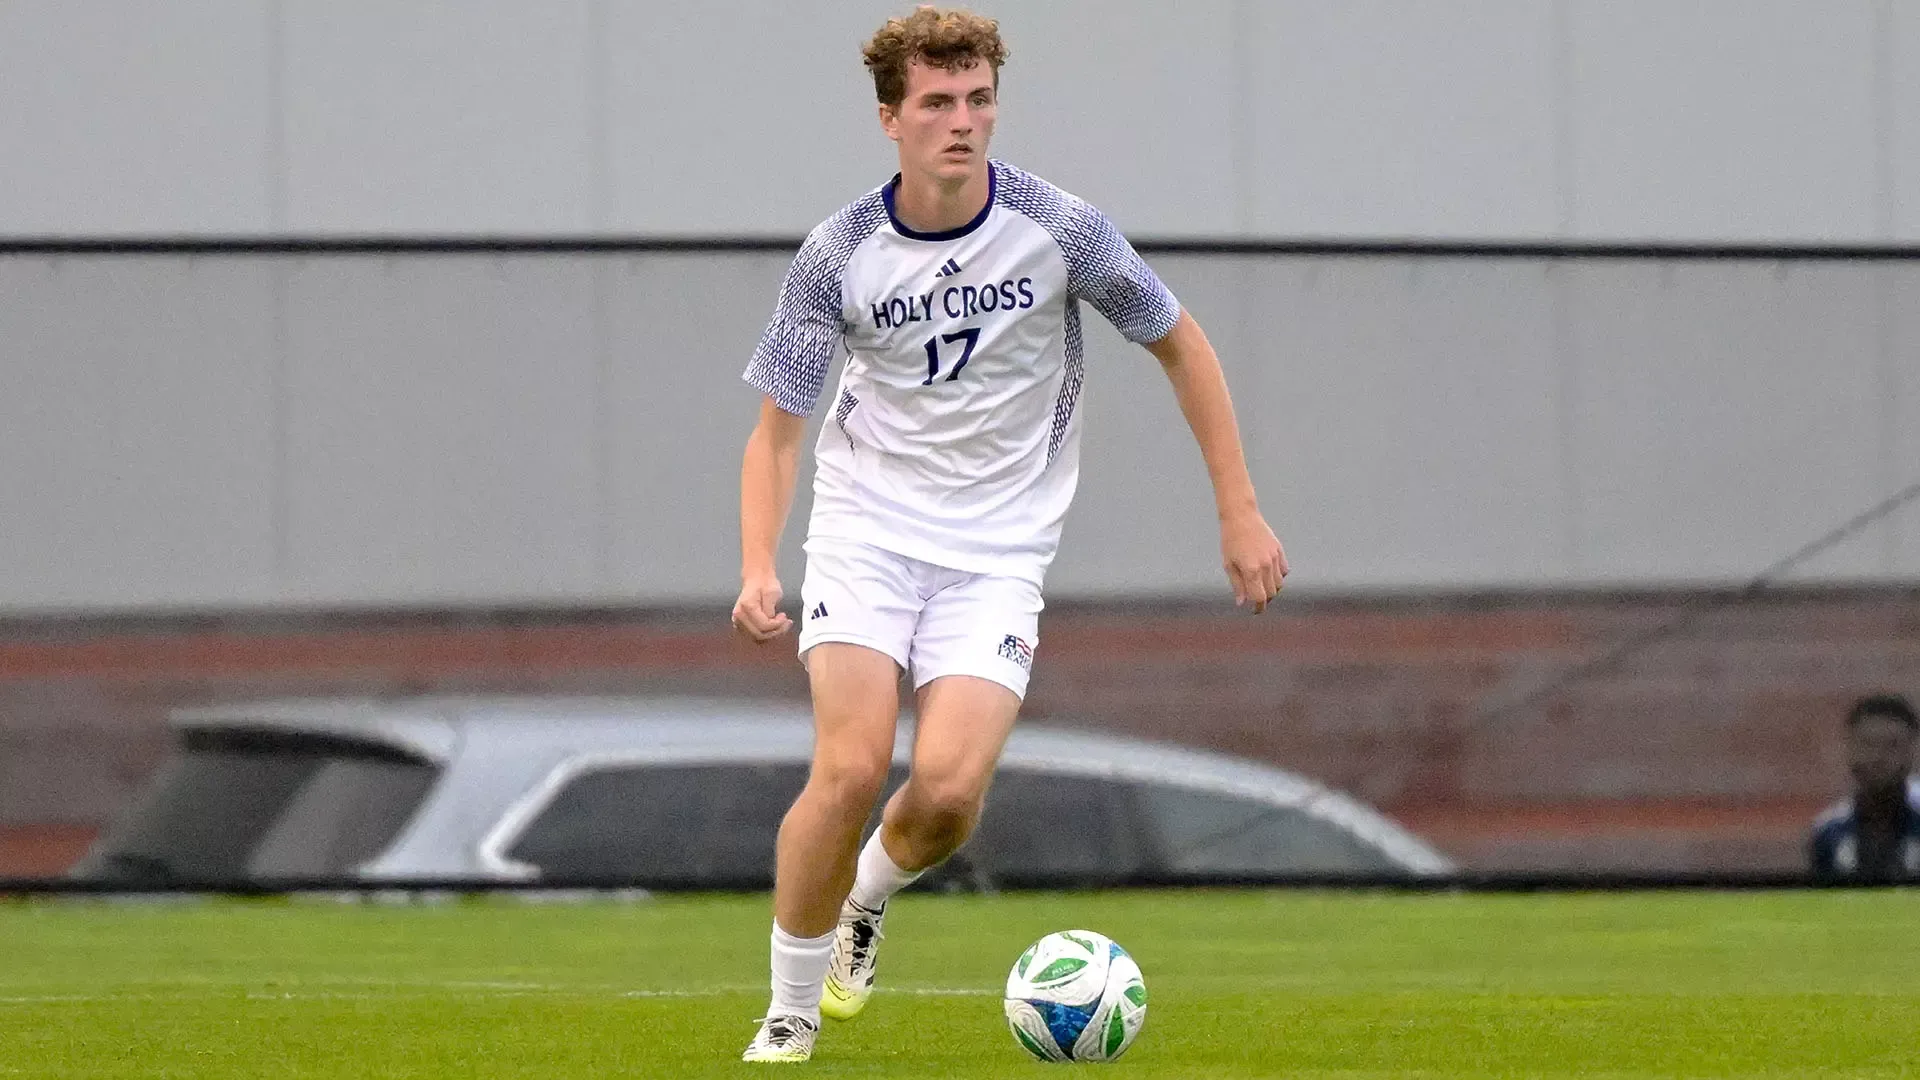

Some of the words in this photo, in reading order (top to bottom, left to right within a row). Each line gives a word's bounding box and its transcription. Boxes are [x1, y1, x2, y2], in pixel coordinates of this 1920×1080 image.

[871, 290, 935, 329] HOLY
[943, 277, 1034, 319] CROSS
[922, 327, 981, 386] 17
